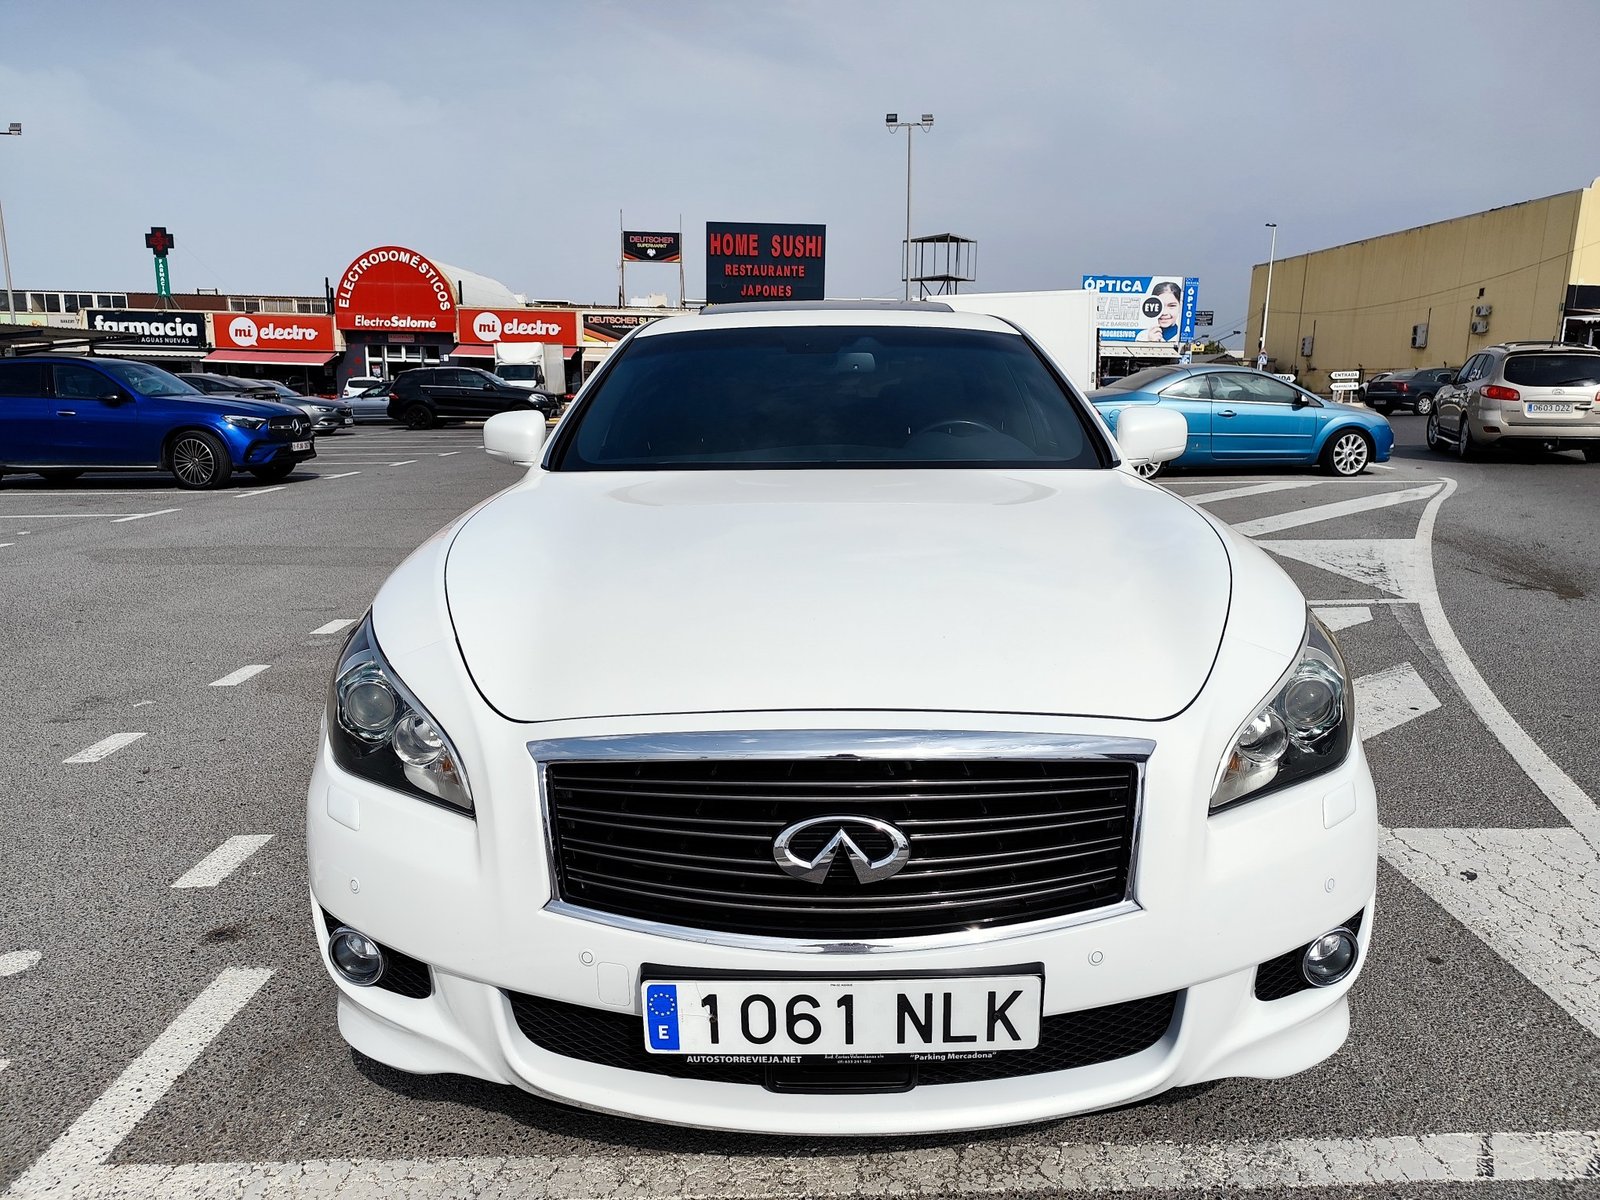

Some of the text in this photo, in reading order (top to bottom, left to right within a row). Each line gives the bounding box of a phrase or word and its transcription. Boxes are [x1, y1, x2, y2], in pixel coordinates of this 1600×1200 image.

[630, 236, 673, 244] DEUTSCHER
[710, 233, 822, 257] HOME SUSHI
[158, 258, 167, 295] FARMACIA
[725, 263, 805, 277] RESTAURANTE
[339, 250, 451, 311] ELECTRODOMÉSTICOS
[1084, 276, 1143, 292] ÓPTICA
[741, 284, 792, 297] JAPONES
[1144, 303, 1160, 312] EYE
[94, 315, 198, 337] farmacia
[355, 315, 437, 329] ElectroSalomé
[479, 318, 562, 336] mi electro
[588, 316, 638, 325] DEUTSCHER
[234, 323, 318, 340] mi electro
[701, 990, 1023, 1045] 1061 NLK
[658, 1025, 670, 1039] E
[686, 1055, 802, 1064] AUTOSTORREVIEJA.NET
